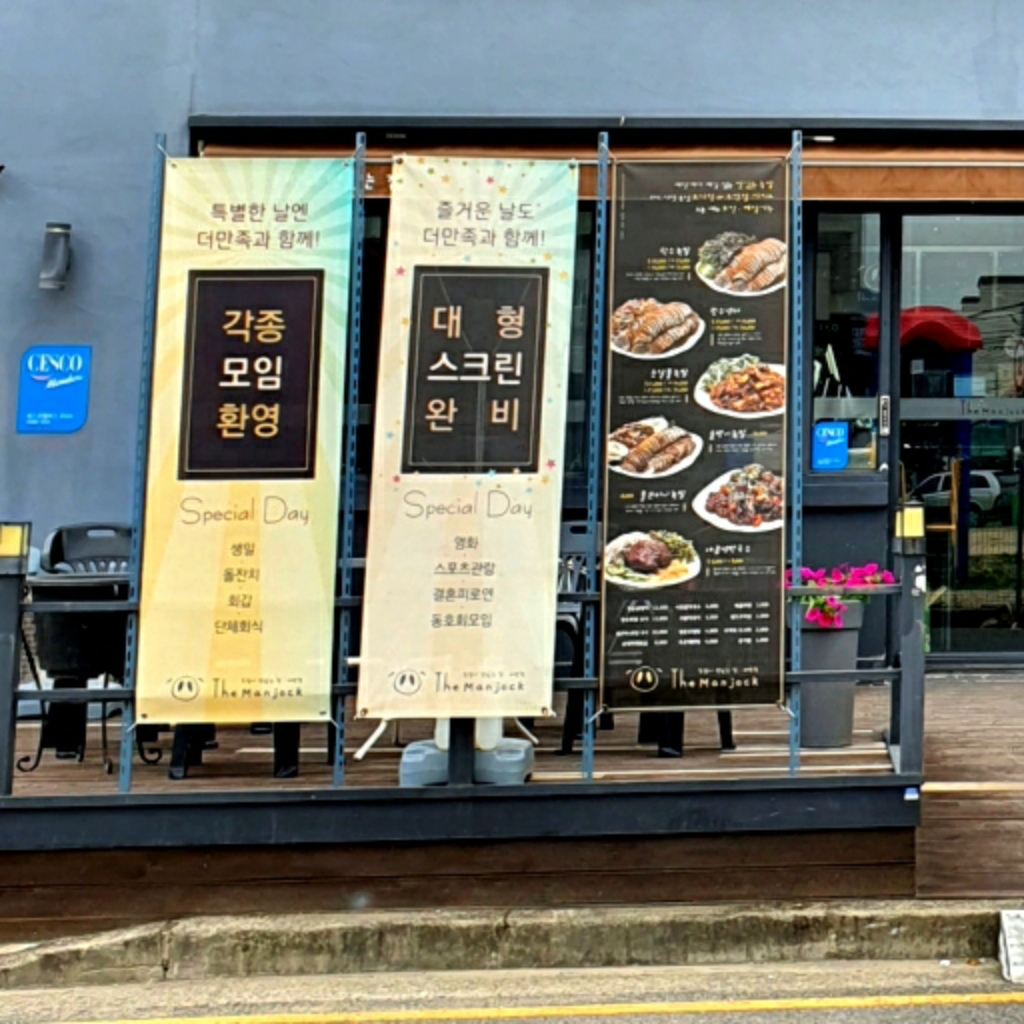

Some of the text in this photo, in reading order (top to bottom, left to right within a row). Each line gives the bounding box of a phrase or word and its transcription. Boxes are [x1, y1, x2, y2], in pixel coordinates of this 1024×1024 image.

[210, 202, 309, 223] 특별한 날엔
[436, 201, 535, 221] 즐거운 날도
[196, 229, 321, 251] 더만족과 함께!
[423, 227, 545, 248] 더만족과 함께!
[221, 308, 287, 344] 각종
[431, 305, 525, 341] 대 형
[217, 354, 283, 391] 모임
[426, 351, 524, 386] 스크린
[215, 403, 282, 439] 환영
[424, 397, 520, 433] 완 비
[179, 494, 310, 527] Special Day
[404, 488, 533, 520] Special Day
[230, 542, 256, 557] 생일
[454, 536, 479, 551] 영화
[433, 561, 496, 577] 스포츠관람
[433, 587, 495, 603] 결혼피로연
[213, 619, 264, 635] 단체회식
[430, 613, 493, 629] 동호회모임
[212, 677, 237, 699] The
[241, 686, 303, 701] Manjock
[434, 671, 459, 693] The
[463, 681, 525, 695] Manjock
[670, 667, 696, 689] The
[699, 676, 759, 690] Manjock
